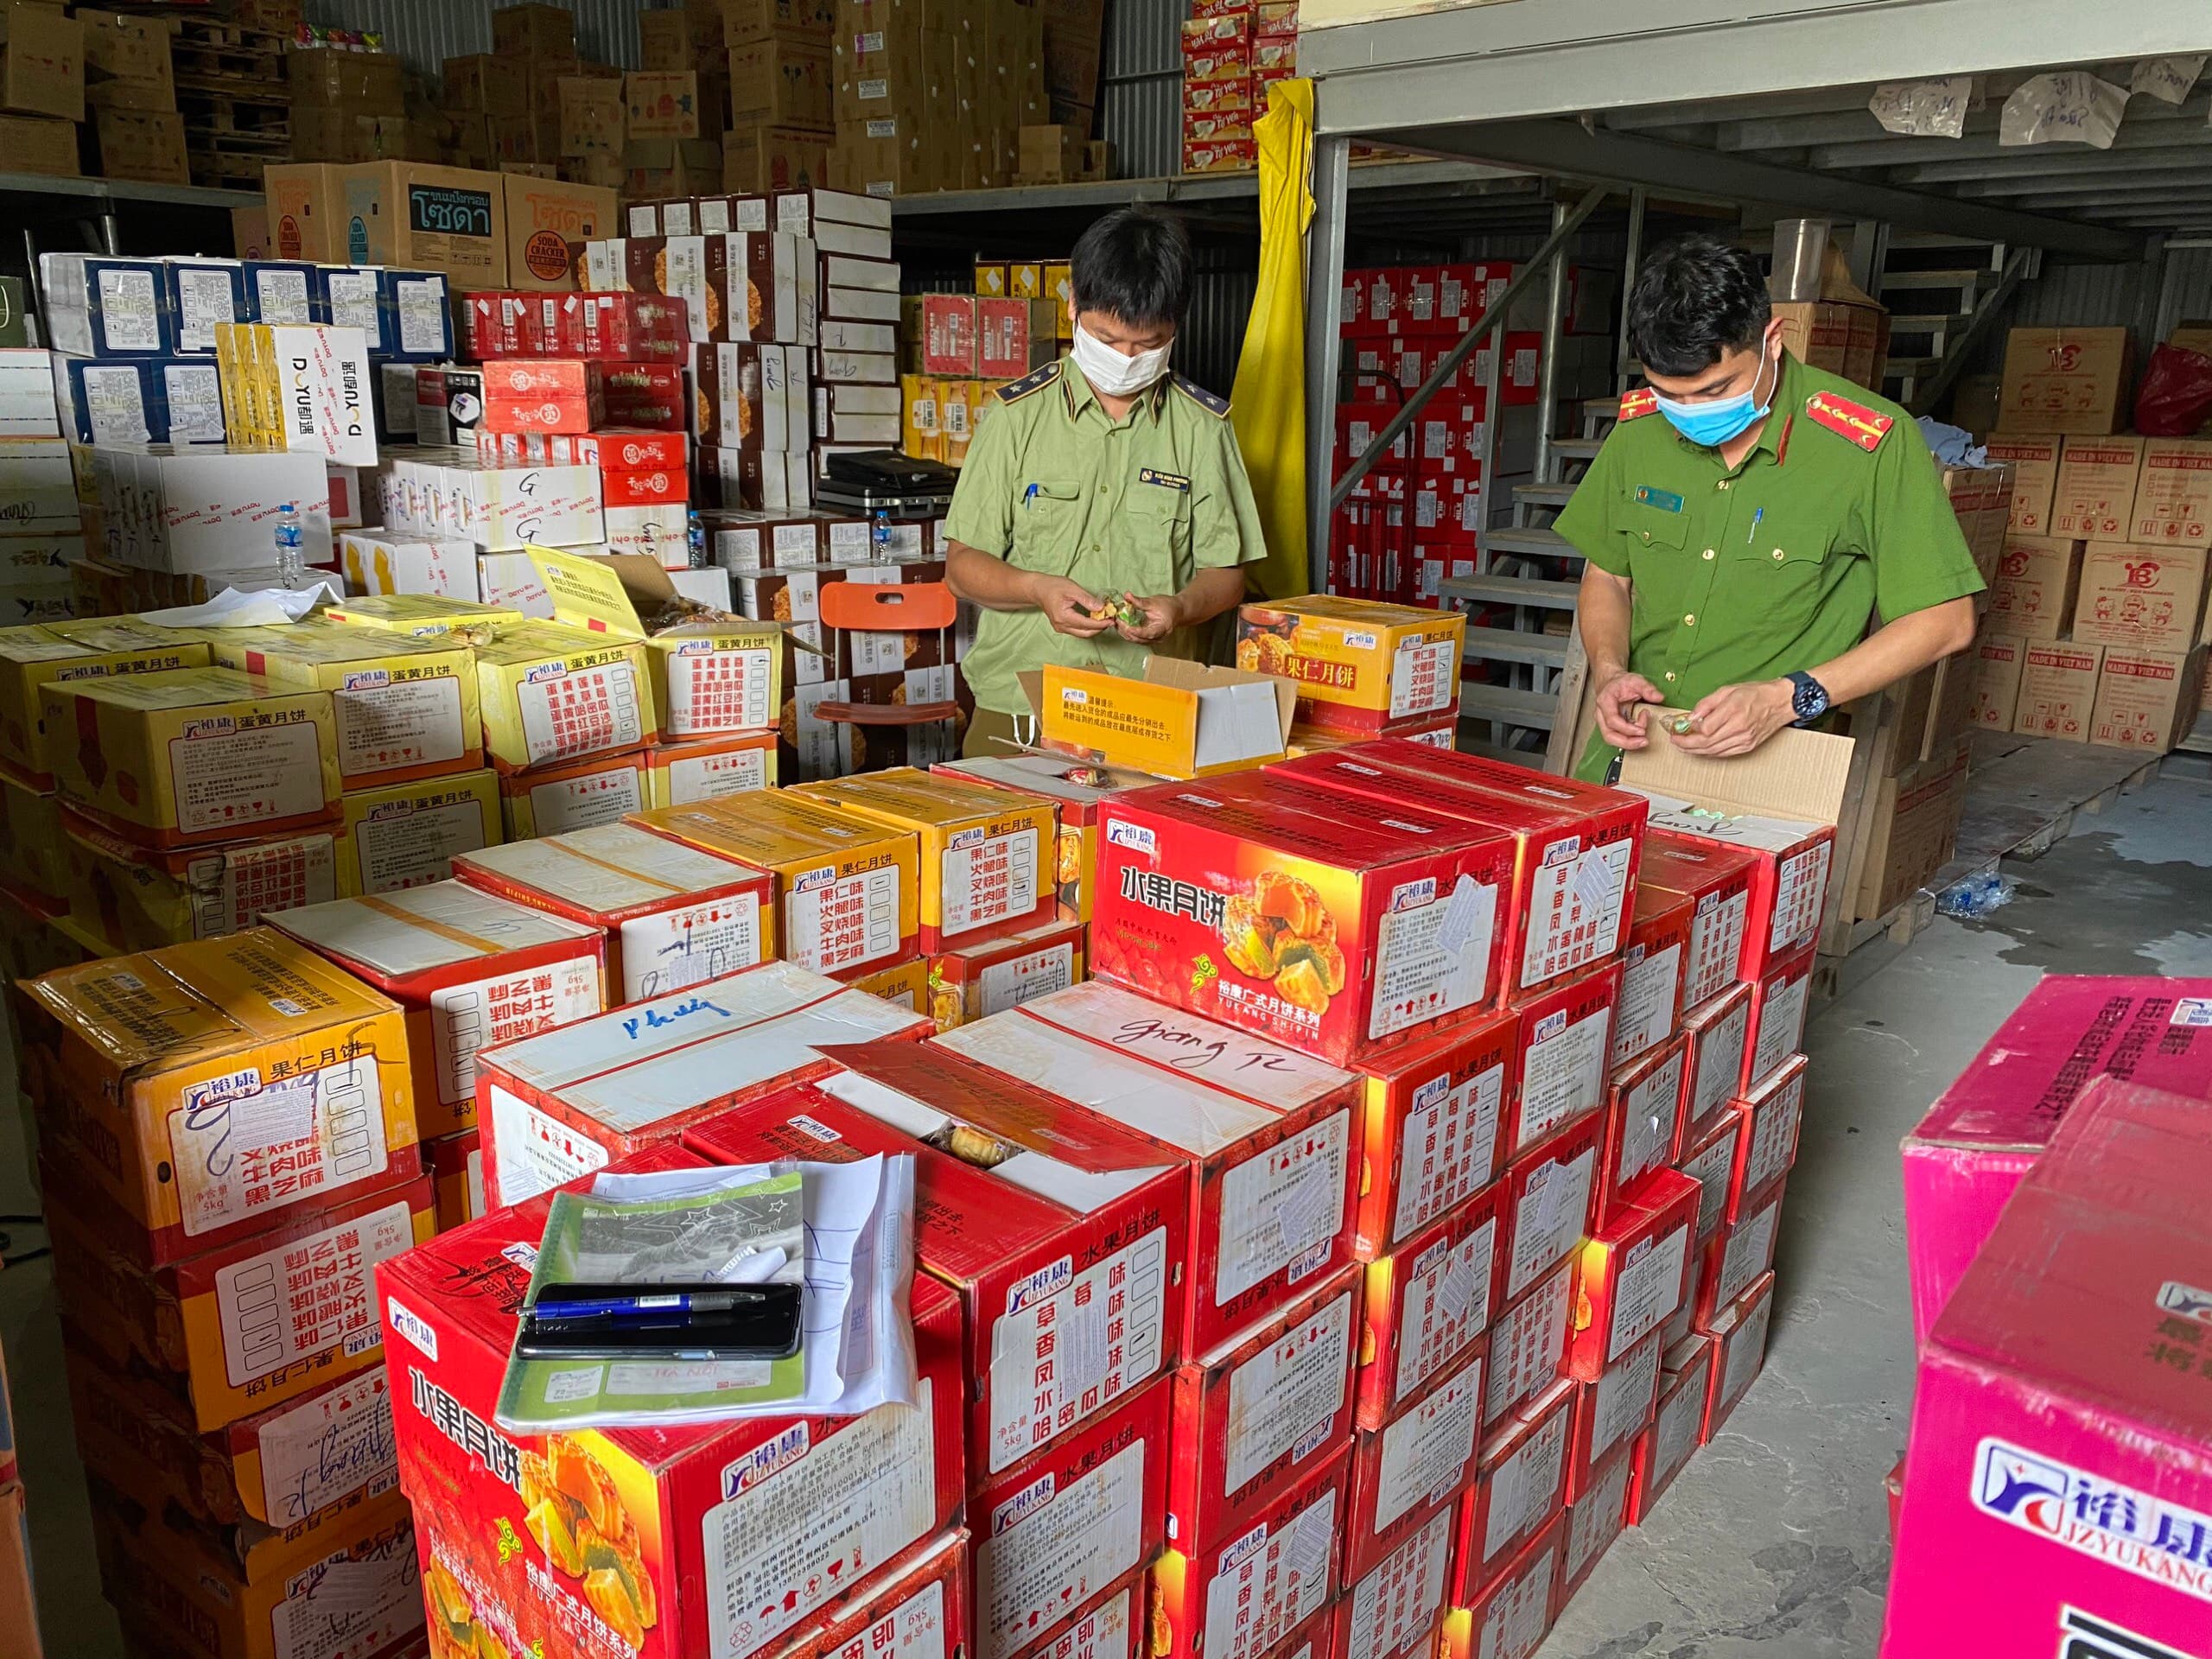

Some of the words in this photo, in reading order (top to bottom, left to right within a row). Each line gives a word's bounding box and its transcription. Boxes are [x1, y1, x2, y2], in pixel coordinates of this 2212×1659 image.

[531, 245, 565, 258] CRACKER
[537, 235, 559, 248] SODA
[2018, 449, 2034, 461] VIET
[2034, 450, 2050, 461] NAM
[2066, 450, 2086, 462] MADE
[2088, 452, 2097, 462] IN
[2098, 452, 2115, 464] VIET
[2116, 453, 2133, 464] NAM
[2150, 456, 2171, 467] MADE
[2172, 458, 2181, 468] IN
[2182, 458, 2199, 469] VIET
[519, 473, 540, 496] G
[516, 518, 543, 543] G
[718, 638, 765, 649] 蛋黄月饼
[1426, 630, 1453, 642] 果仁月饼
[114, 656, 181, 674] 蛋黄月饼
[570, 650, 624, 668] 蛋黄月饼
[1998, 650, 2014, 662] NAM
[2029, 652, 2049, 664] MADE
[2050, 655, 2058, 666] IN
[2059, 657, 2075, 668] VIET
[2076, 658, 2094, 671] NAM
[392, 665, 451, 681] 蛋黄月饼
[1287, 658, 1355, 689] 果仁月饼
[2106, 661, 2127, 673] MADE
[2128, 664, 2137, 674] IN
[2138, 665, 2155, 677] VIET
[2156, 667, 2175, 679] NAM
[238, 709, 307, 728] 蛋黄月饼
[415, 790, 474, 810] 蛋黄月饼
[988, 817, 1033, 836] 果仁月饼
[1585, 823, 1633, 847] 水果月饼
[842, 853, 893, 875] 果仁月饼
[970, 842, 1008, 861] 果仁味
[970, 857, 1008, 877] 火腿味
[819, 880, 864, 903] 果仁味
[970, 872, 1008, 892] 叉烧味
[820, 896, 864, 919] 火腿味
[970, 887, 1007, 906] 牛肉味
[1120, 865, 1227, 929] 水果月饼
[969, 900, 1007, 922] 黑芝麻
[820, 912, 864, 936] 叉烧味
[820, 927, 864, 950] 牛肉味
[1547, 920, 1599, 954] 水蜜桃味
[820, 943, 864, 968] 黑芝麻
[1544, 942, 1595, 976] 哈密瓜味
[487, 973, 552, 1003] 黑芝麻
[874, 979, 909, 999] 仁月饼
[489, 995, 554, 1022] 牛肉味
[1217, 978, 1321, 1028] 裕康广式月饼系列
[1217, 995, 1267, 1022] YUKANG
[1272, 1015, 1319, 1041] SHIPIN
[270, 1039, 363, 1080] 果仁月饼
[1456, 1047, 1503, 1080] 水果月饼
[210, 1071, 256, 1095] 裕康
[1427, 1085, 1479, 1130] 草莓味
[1426, 1109, 1477, 1155] 香橙味
[242, 1146, 323, 1185] 牛肉味
[1422, 1131, 1474, 1179] 凤梨味
[245, 1166, 325, 1208] 黑芝麻
[1420, 1154, 1472, 1201] 水蜜桃味
[193, 1185, 229, 1205] 净含量
[202, 1199, 225, 1211] 5kg
[1416, 1177, 1469, 1225] 哈密瓜味
[377, 1225, 396, 1236] 5kg
[1082, 1210, 1161, 1265] 水果月饼
[283, 1228, 360, 1273] 黑芝麻
[288, 1251, 363, 1293] 牛肉味
[1032, 1260, 1070, 1289] 裕康
[290, 1268, 365, 1313] 叉烧味
[1036, 1260, 1127, 1329] 草莓味
[293, 1288, 367, 1332] 火腿味
[295, 1307, 369, 1351] 果仁味
[245, 1349, 336, 1399] 果仁月饼
[1032, 1370, 1122, 1446] 哈密瓜味
[407, 1364, 521, 1494] 水果月饼
[996, 1414, 1027, 1441] 净含量
[753, 1426, 804, 1469] 裕康
[1003, 1432, 1022, 1450] 5kg
[753, 1445, 804, 1484] JZYUKANG
[1060, 1426, 1135, 1486] 水果月饼
[1014, 1478, 1052, 1512] 裕康
[1273, 1476, 1333, 1529] 水果月饼
[2063, 1522, 2212, 1595] JZYUKANG
[907, 1606, 928, 1627] 5kg
